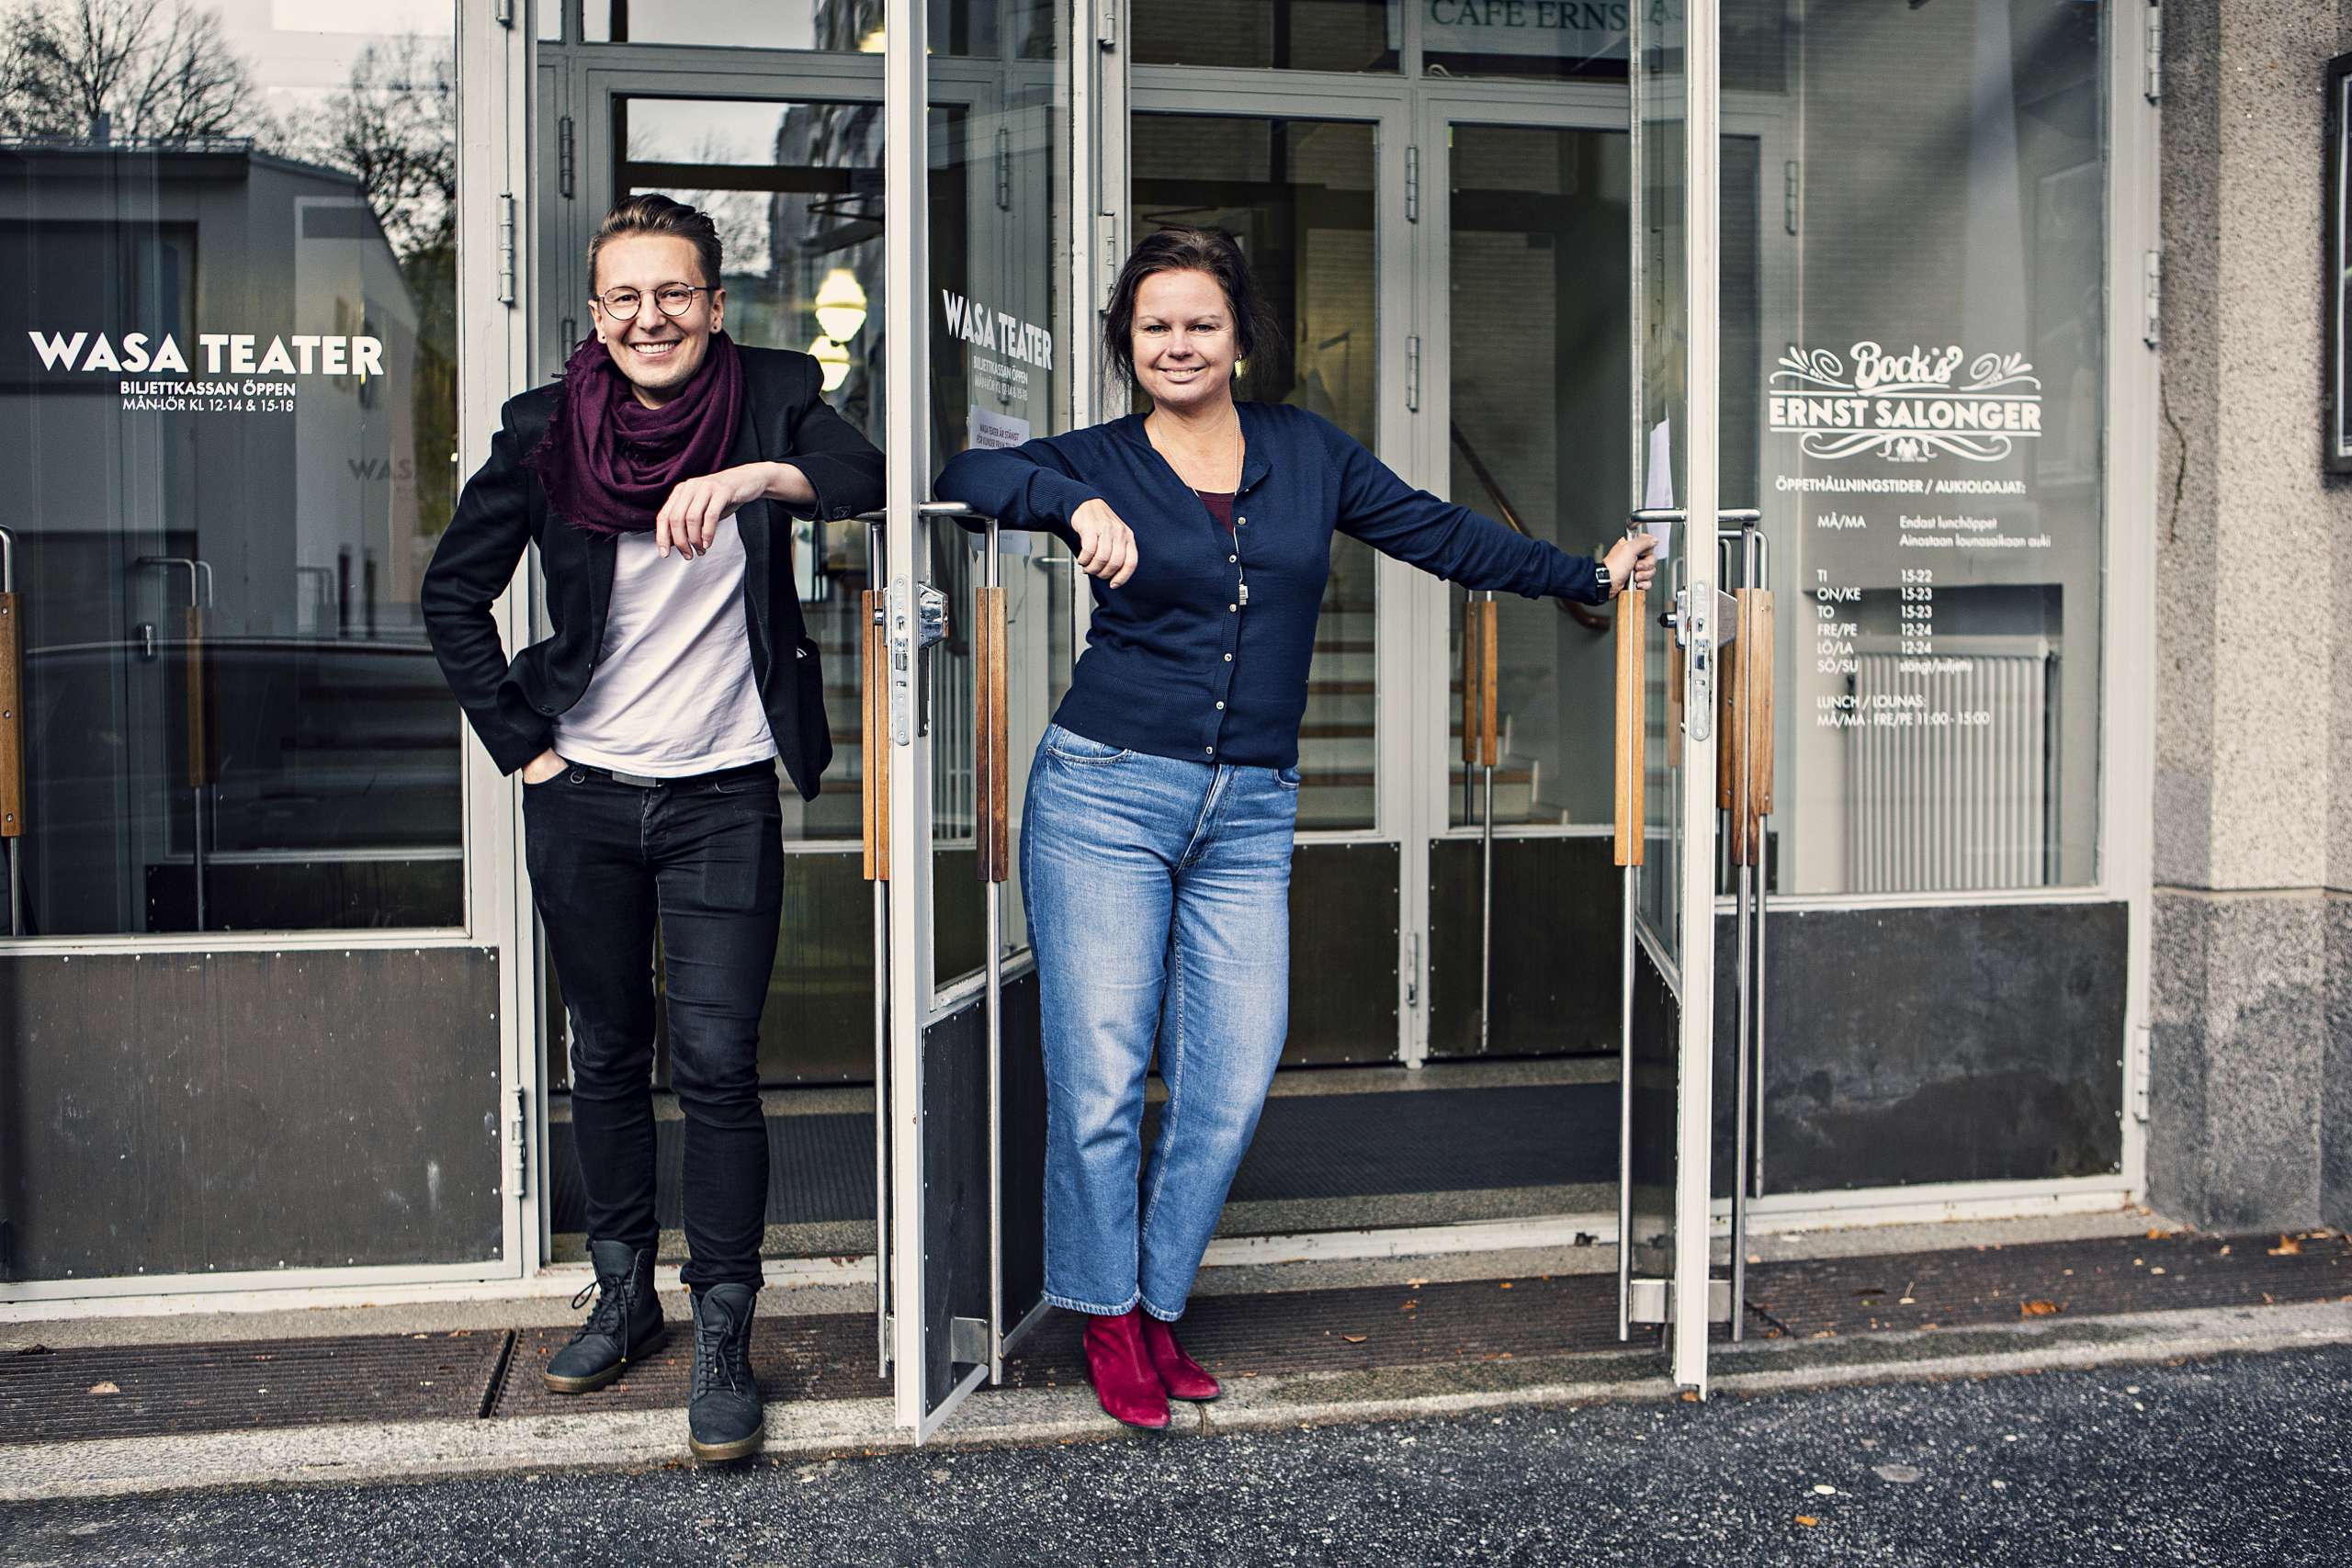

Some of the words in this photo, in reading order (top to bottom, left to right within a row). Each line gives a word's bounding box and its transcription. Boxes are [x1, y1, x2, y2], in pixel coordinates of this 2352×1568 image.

[1536, 1, 1628, 31] ERNS
[943, 288, 996, 352] WASA
[998, 311, 1052, 370] TEATER
[28, 331, 189, 373] WASA
[199, 333, 384, 375] TEATER
[120, 381, 239, 396] BILJETTKASSAN
[243, 378, 296, 397] ÖPPEN
[122, 395, 186, 411] MÅN-LÖR
[189, 399, 204, 411] KL
[209, 399, 243, 412] 12-14
[246, 400, 256, 412] &
[261, 400, 294, 412] 15-18
[1769, 397, 1869, 428] ERNST
[1874, 399, 2041, 431] SALONGER
[347, 458, 413, 479] WAS
[1775, 475, 1924, 493] ÖPPETHÅLLNINGSTIDER
[1925, 479, 1933, 495] /
[1935, 479, 2026, 495] AUKIOLOAJAT:
[1817, 511, 1867, 531] MÅ/MA
[1899, 514, 1936, 529] Endast
[1816, 570, 1827, 582] TI
[1901, 569, 1933, 583] 15-22
[1816, 587, 1861, 603] ON/KE
[1901, 587, 1933, 602] 15-23
[1816, 604, 1835, 619] TO
[1901, 604, 1933, 619] 15-23
[1816, 622, 1858, 638] FRE/PE
[1901, 623, 1932, 637] 12-24
[1816, 639, 1854, 657] LÖ/LA
[1901, 640, 1932, 655] 12-24
[1816, 657, 1859, 674] SÖ/SU
[1816, 694, 1860, 709] LUNCH
[1862, 694, 1870, 710] /
[1816, 711, 1865, 729] MÅ/MA
[1874, 712, 1913, 728] FRE/PE
